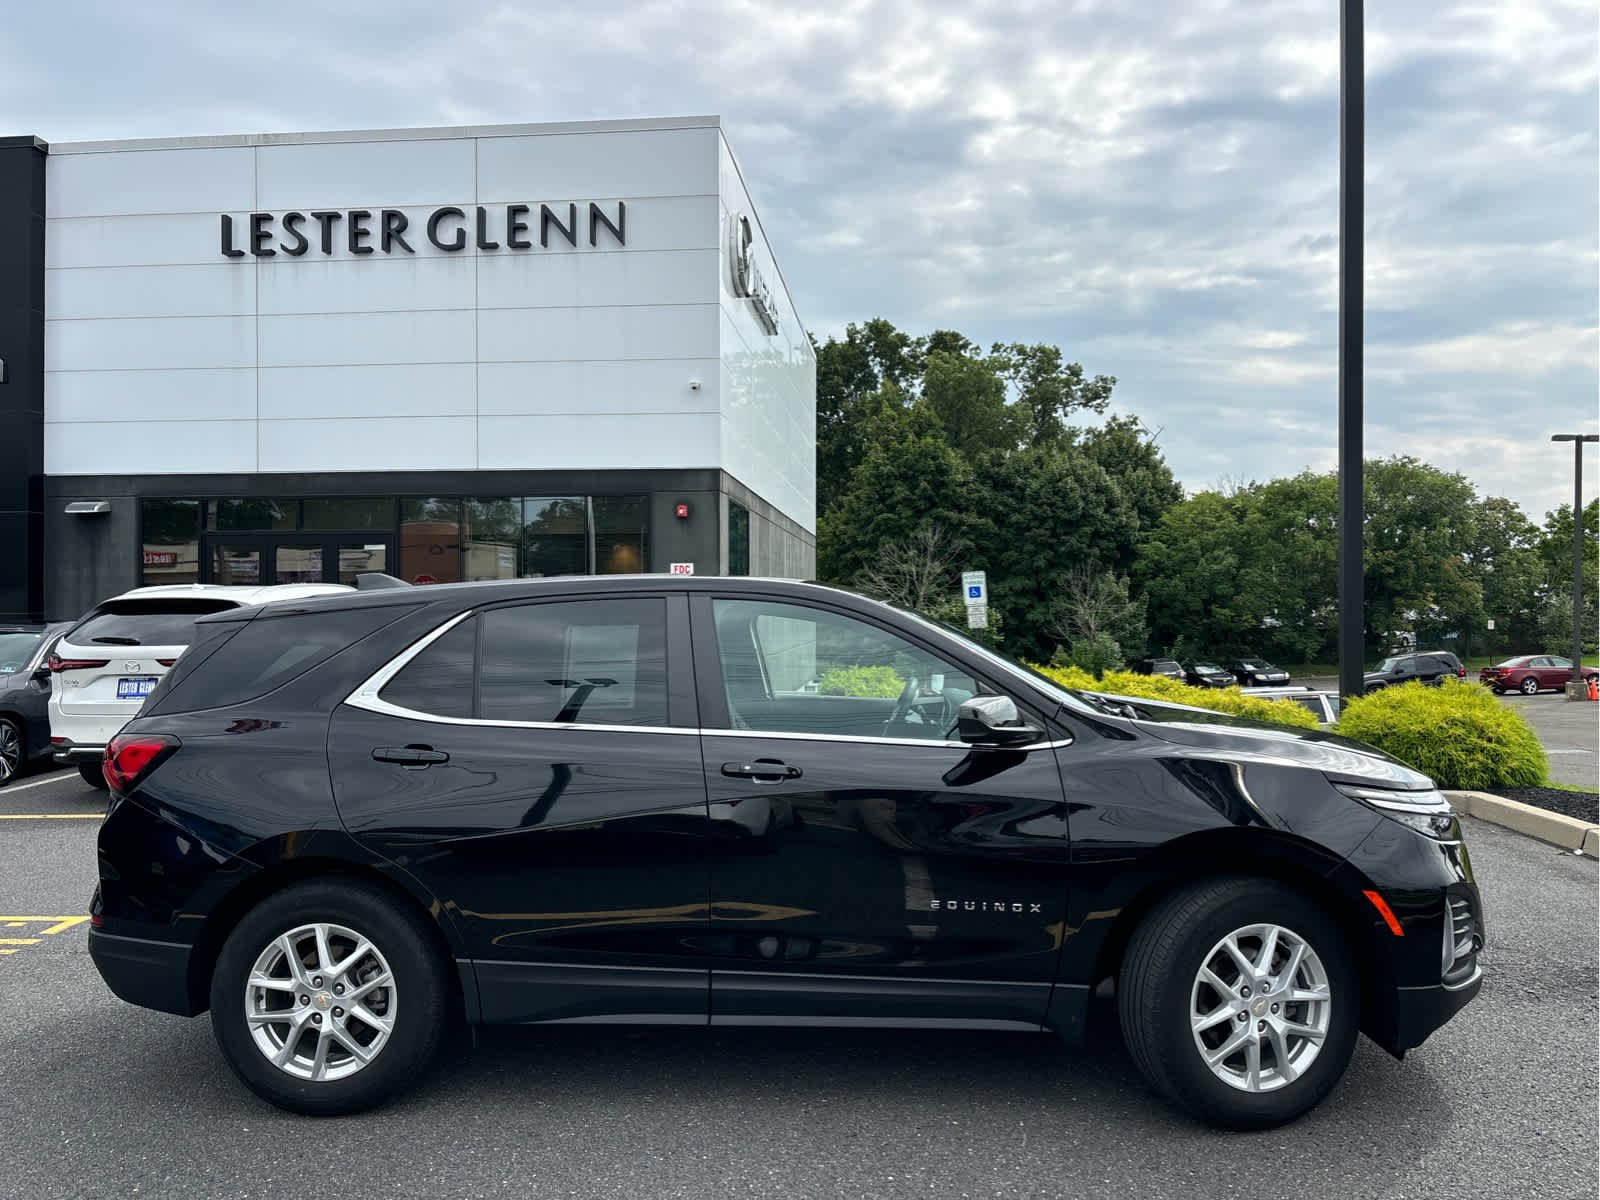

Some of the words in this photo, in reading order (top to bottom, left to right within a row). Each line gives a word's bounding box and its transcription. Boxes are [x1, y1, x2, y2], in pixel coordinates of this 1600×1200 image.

[221, 208, 416, 258] LESTER
[426, 201, 626, 252] GLENN
[673, 564, 691, 575] FDC
[118, 681, 139, 694] LESTER
[930, 900, 1041, 913] EQUINOX
